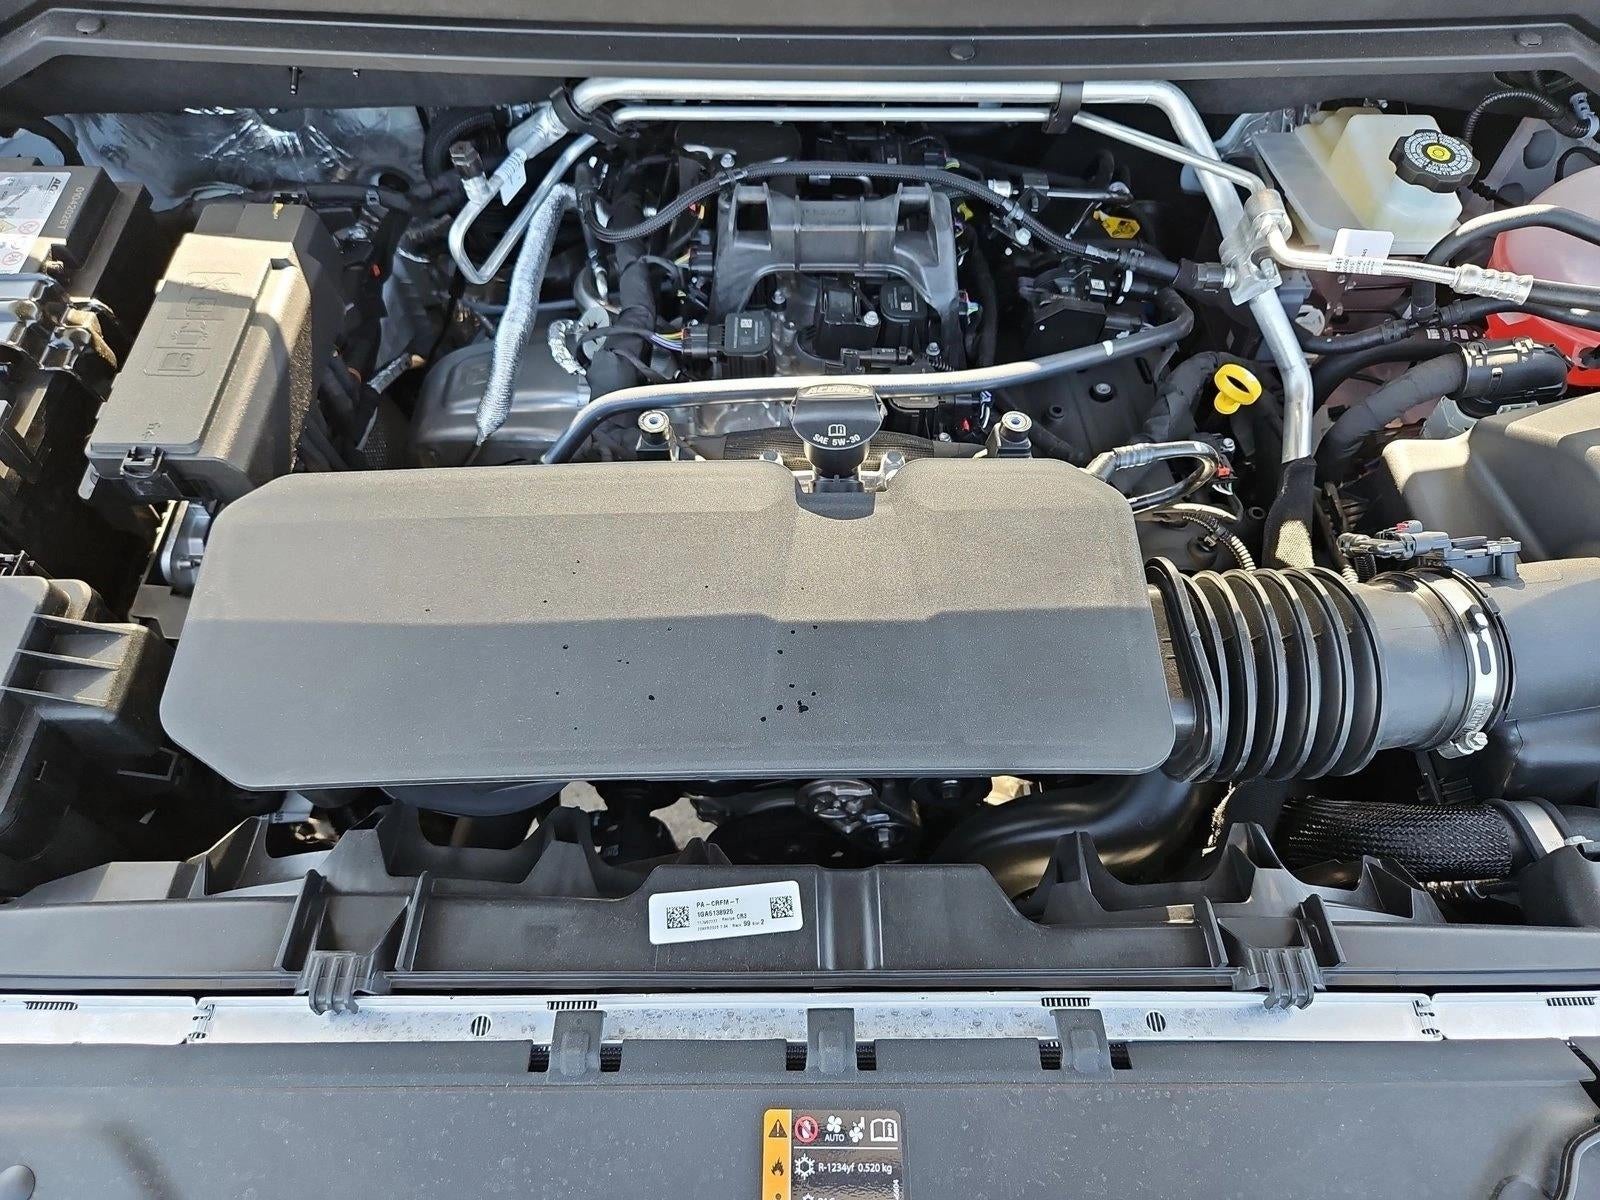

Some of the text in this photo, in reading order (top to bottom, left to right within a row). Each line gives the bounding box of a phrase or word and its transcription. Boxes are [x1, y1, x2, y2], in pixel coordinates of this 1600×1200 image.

[813, 433, 861, 446] SAE 5W-30
[824, 1133, 845, 1142] AUTO
[818, 1162, 893, 1175] R-1234yf 0.520 kg
